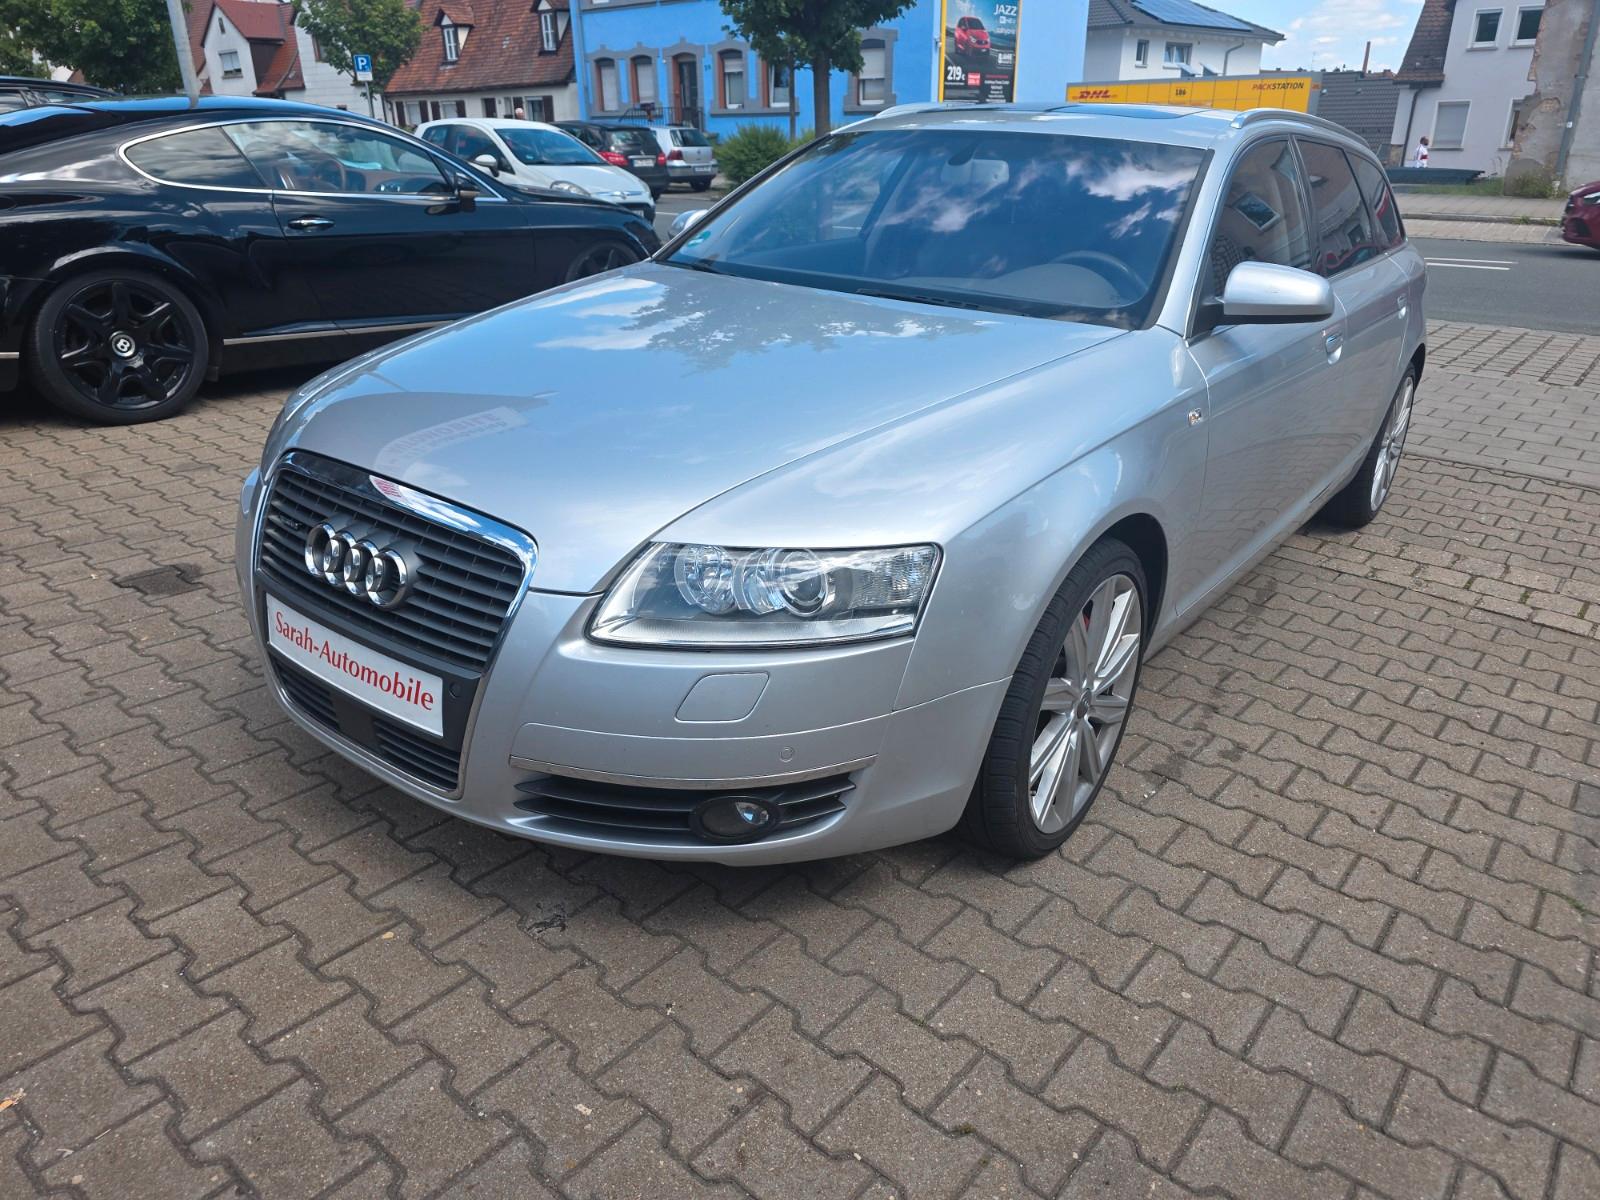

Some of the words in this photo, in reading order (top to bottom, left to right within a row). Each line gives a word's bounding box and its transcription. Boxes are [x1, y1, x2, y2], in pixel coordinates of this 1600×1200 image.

[994, 4, 1017, 16] JAZZ
[358, 57, 367, 70] P
[1252, 82, 1304, 91] PACKSTATION
[1079, 89, 1112, 100] DHL
[275, 611, 435, 712] Sarah-Automobile
